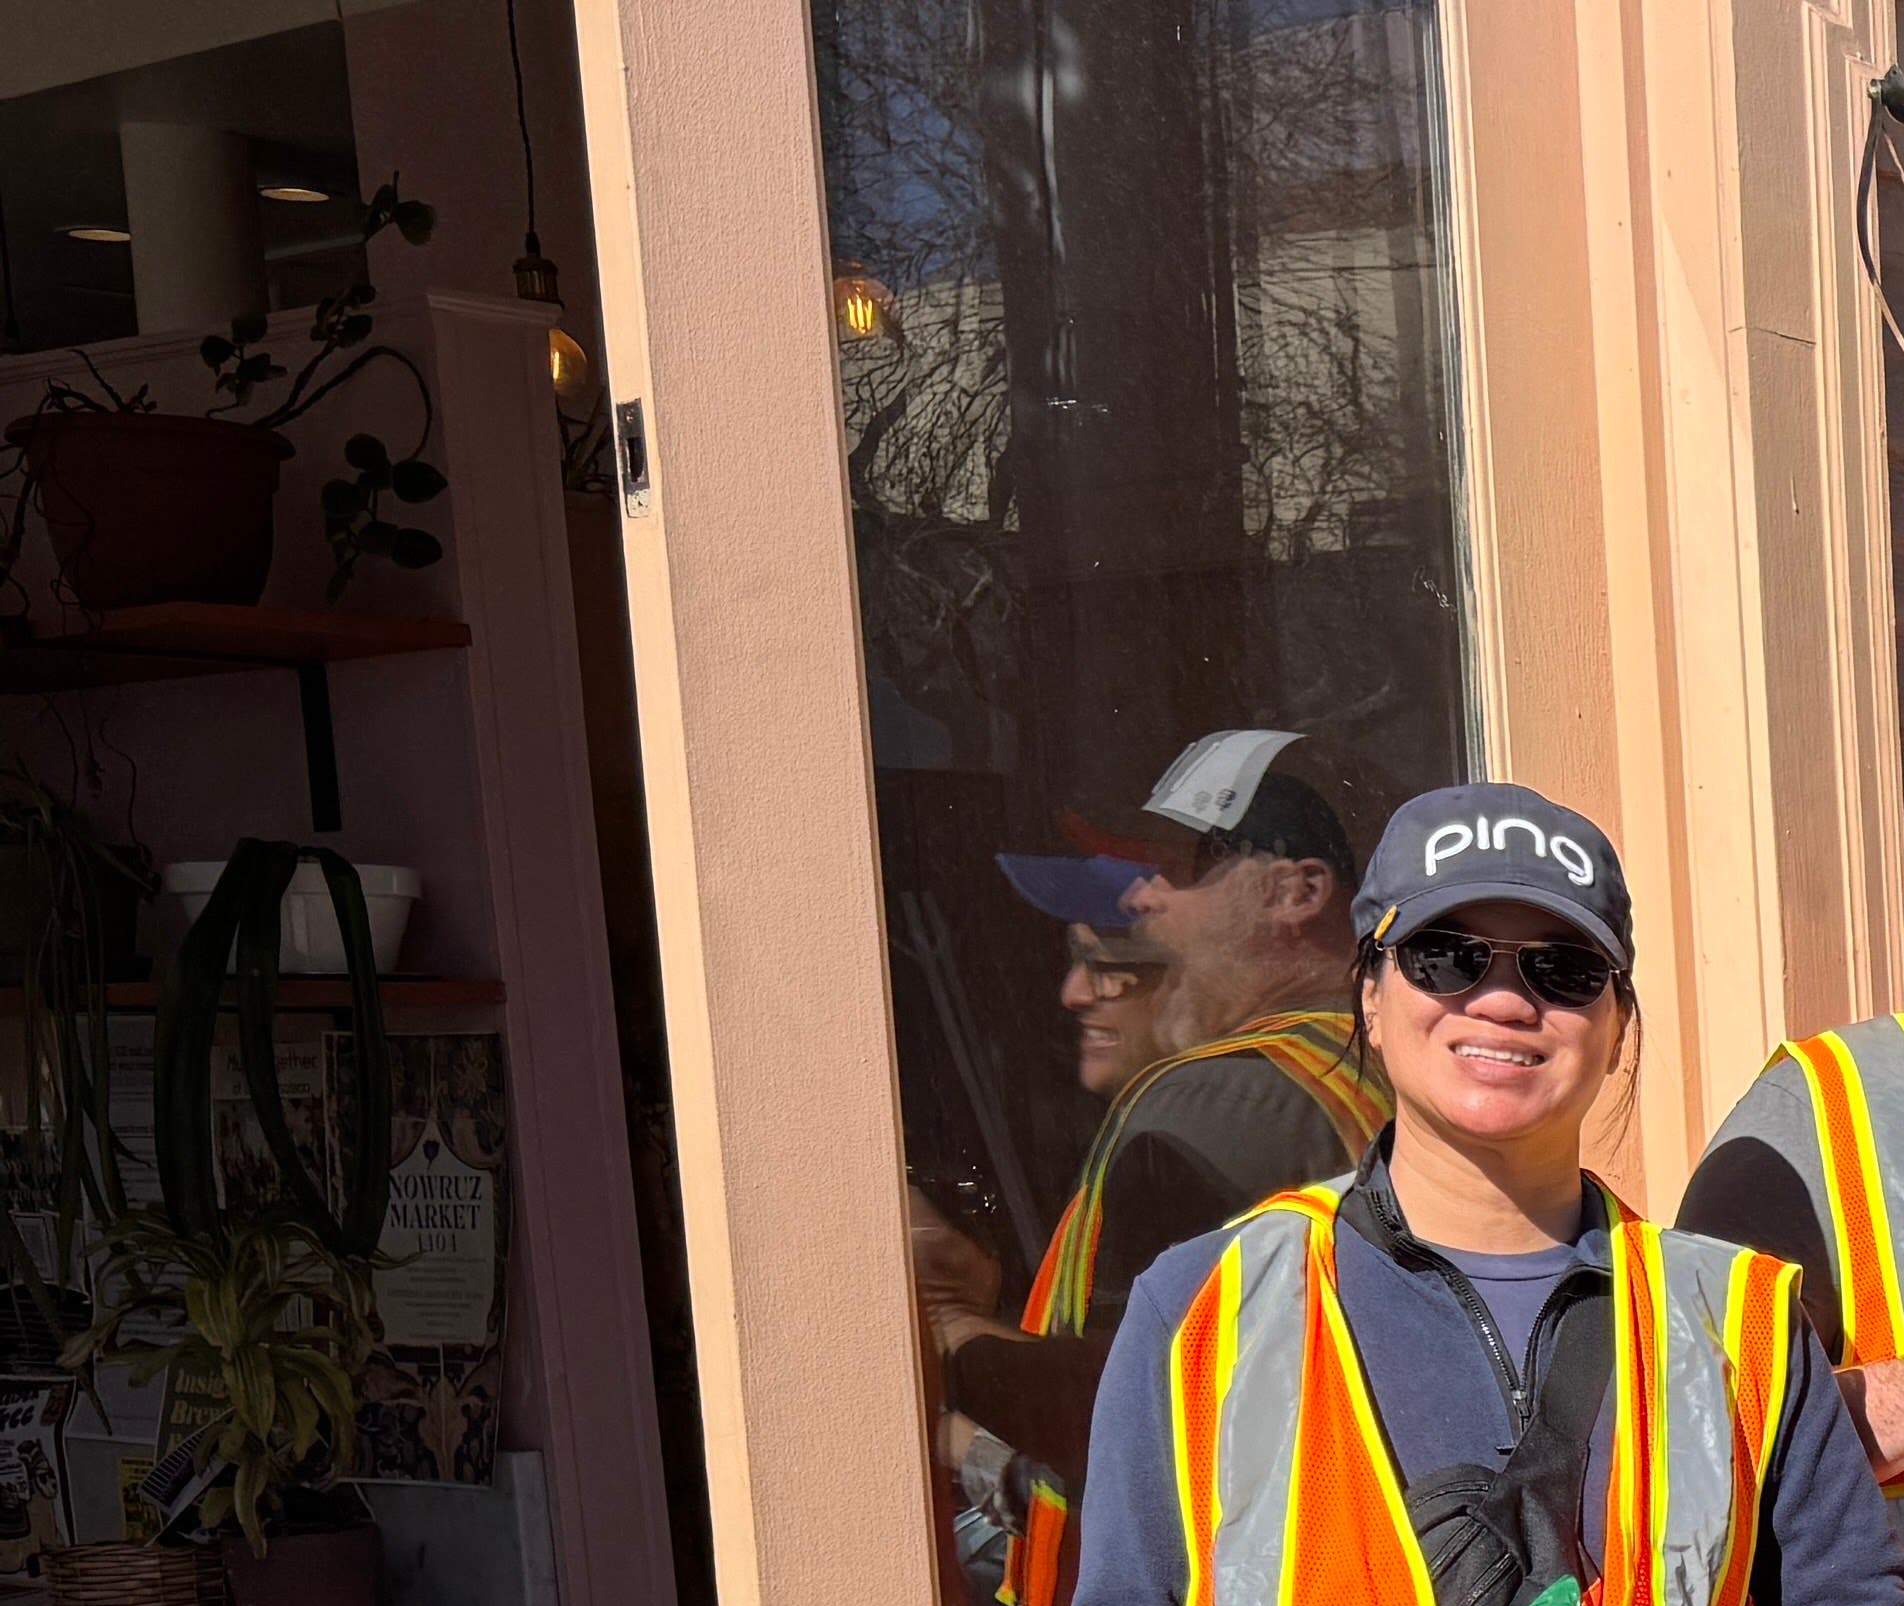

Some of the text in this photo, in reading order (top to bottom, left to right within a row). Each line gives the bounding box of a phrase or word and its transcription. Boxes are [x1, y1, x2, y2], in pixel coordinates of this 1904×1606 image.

[1425, 815, 1594, 886] ping
[389, 1174, 482, 1200] NOWRUZ
[390, 1203, 481, 1230] MARKET
